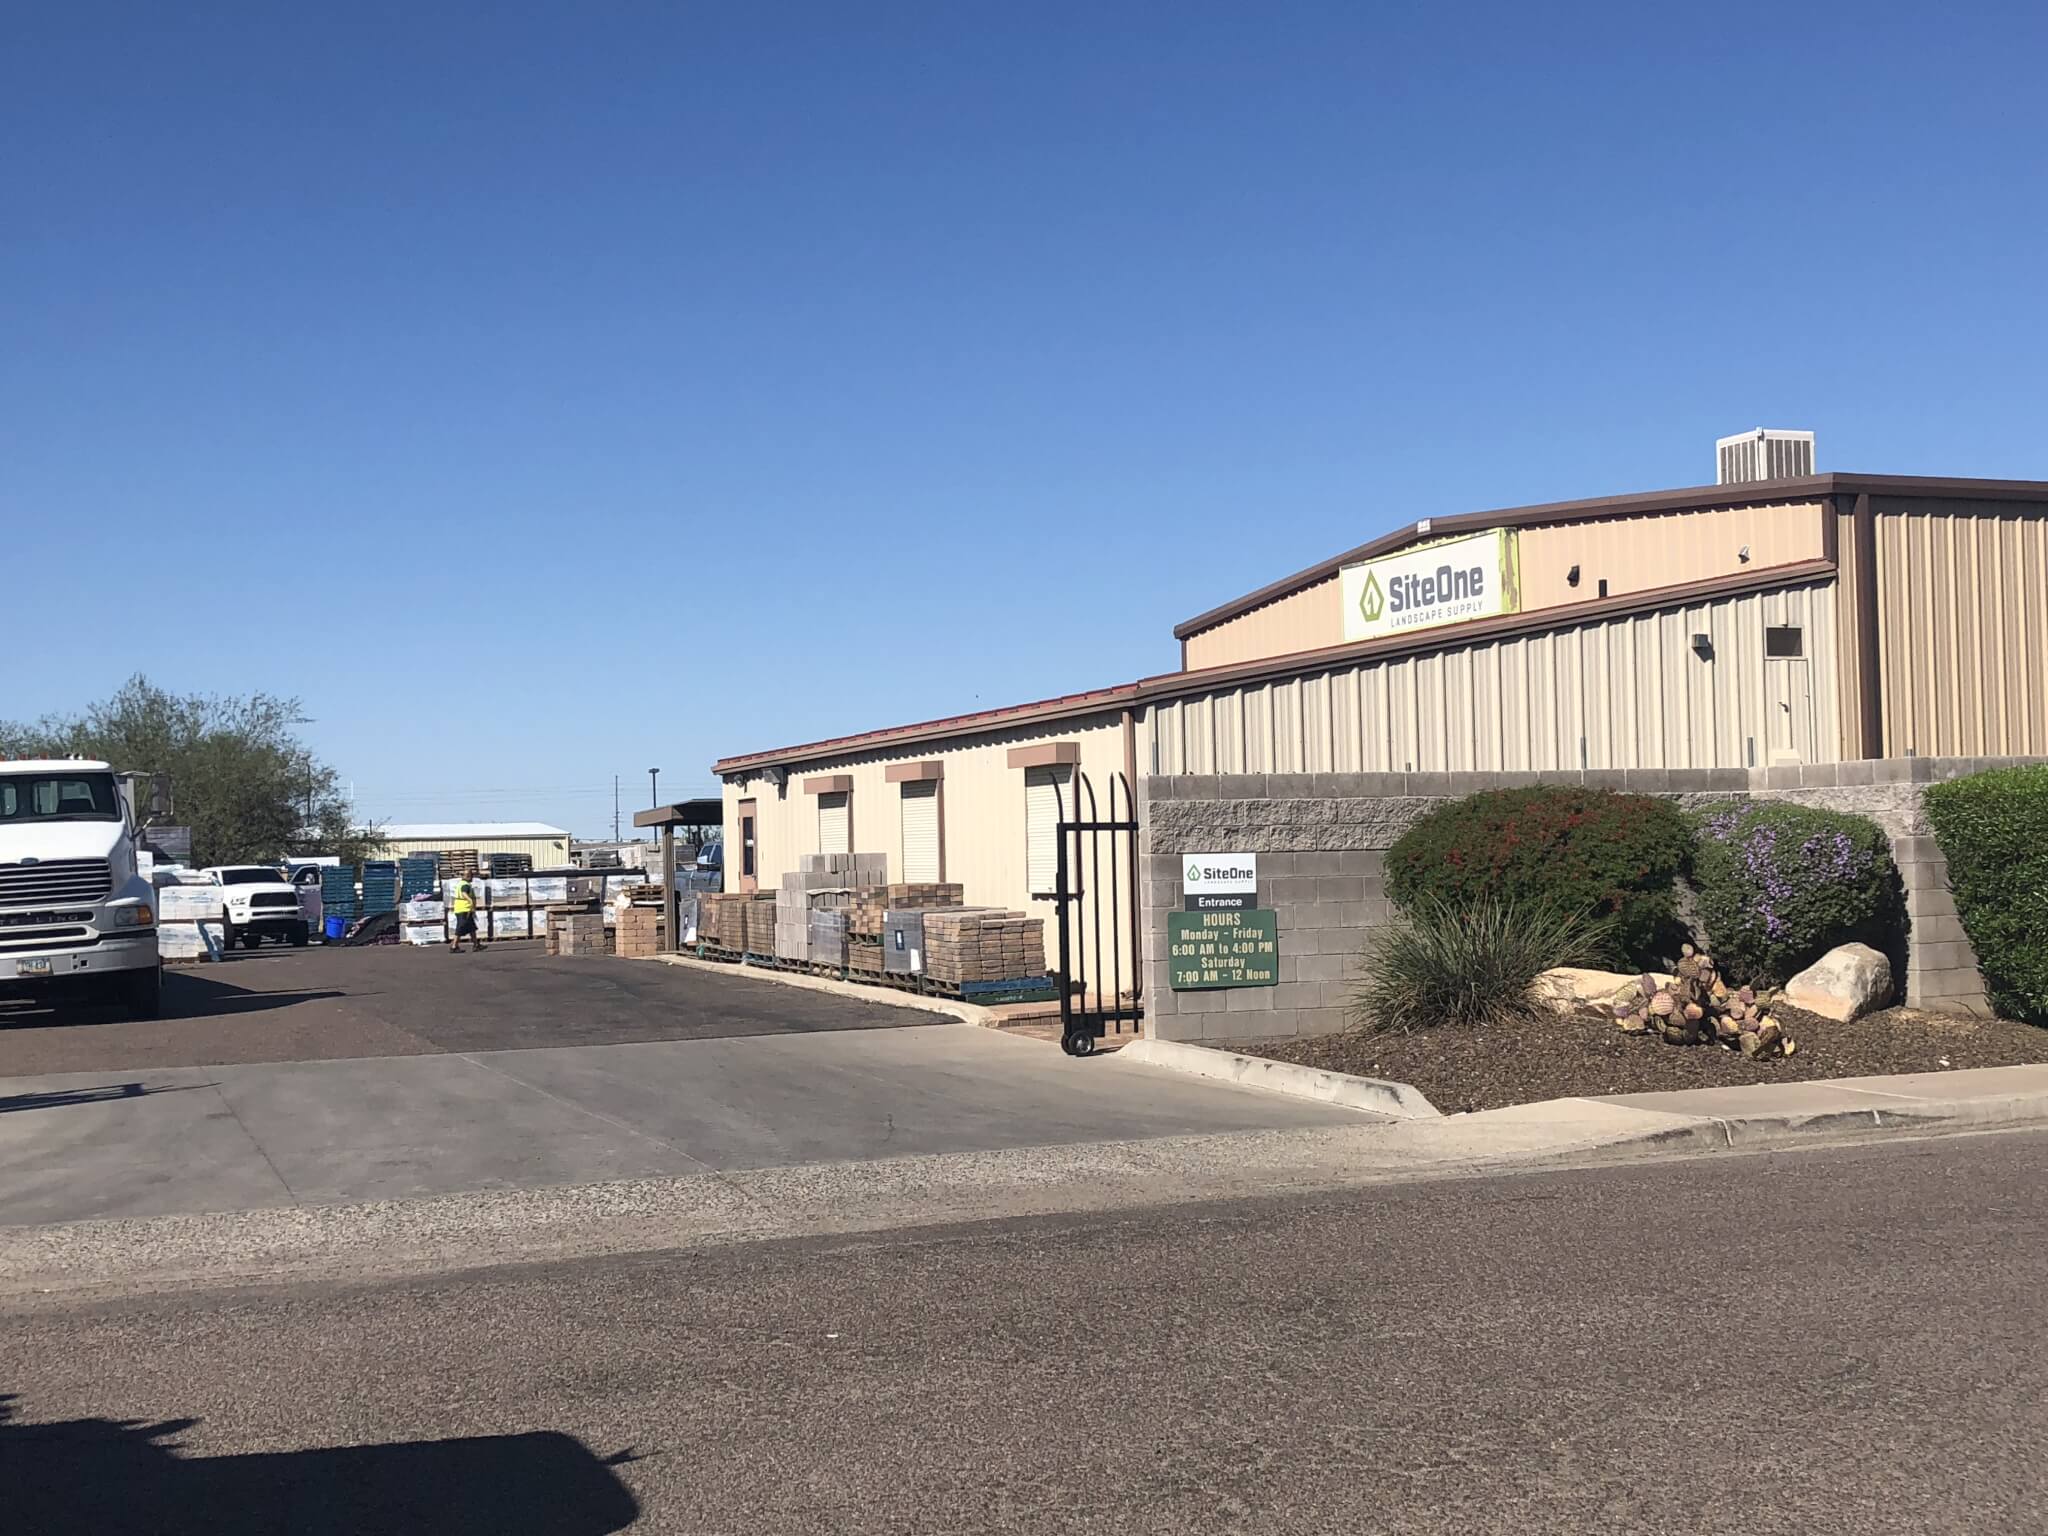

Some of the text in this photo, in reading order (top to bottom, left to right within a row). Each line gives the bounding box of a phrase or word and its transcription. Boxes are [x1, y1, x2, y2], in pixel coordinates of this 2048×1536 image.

[1389, 565, 1484, 612] SiteOne
[1391, 600, 1483, 627] LANDSCAPE SUPPLY
[1204, 867, 1254, 879] SiteOne
[1198, 896, 1243, 908] Entrance
[1203, 912, 1241, 927] HOURS
[1181, 929, 1219, 942] Monday
[1232, 927, 1264, 940] Friday
[1172, 941, 1273, 956] 6:00 AM to 4:00 PM
[1200, 956, 1246, 969] Saturday
[1176, 971, 1199, 983] 7:00
[1203, 970, 1219, 982] AM
[1231, 969, 1243, 981] 12
[1246, 968, 1271, 980] Noon
